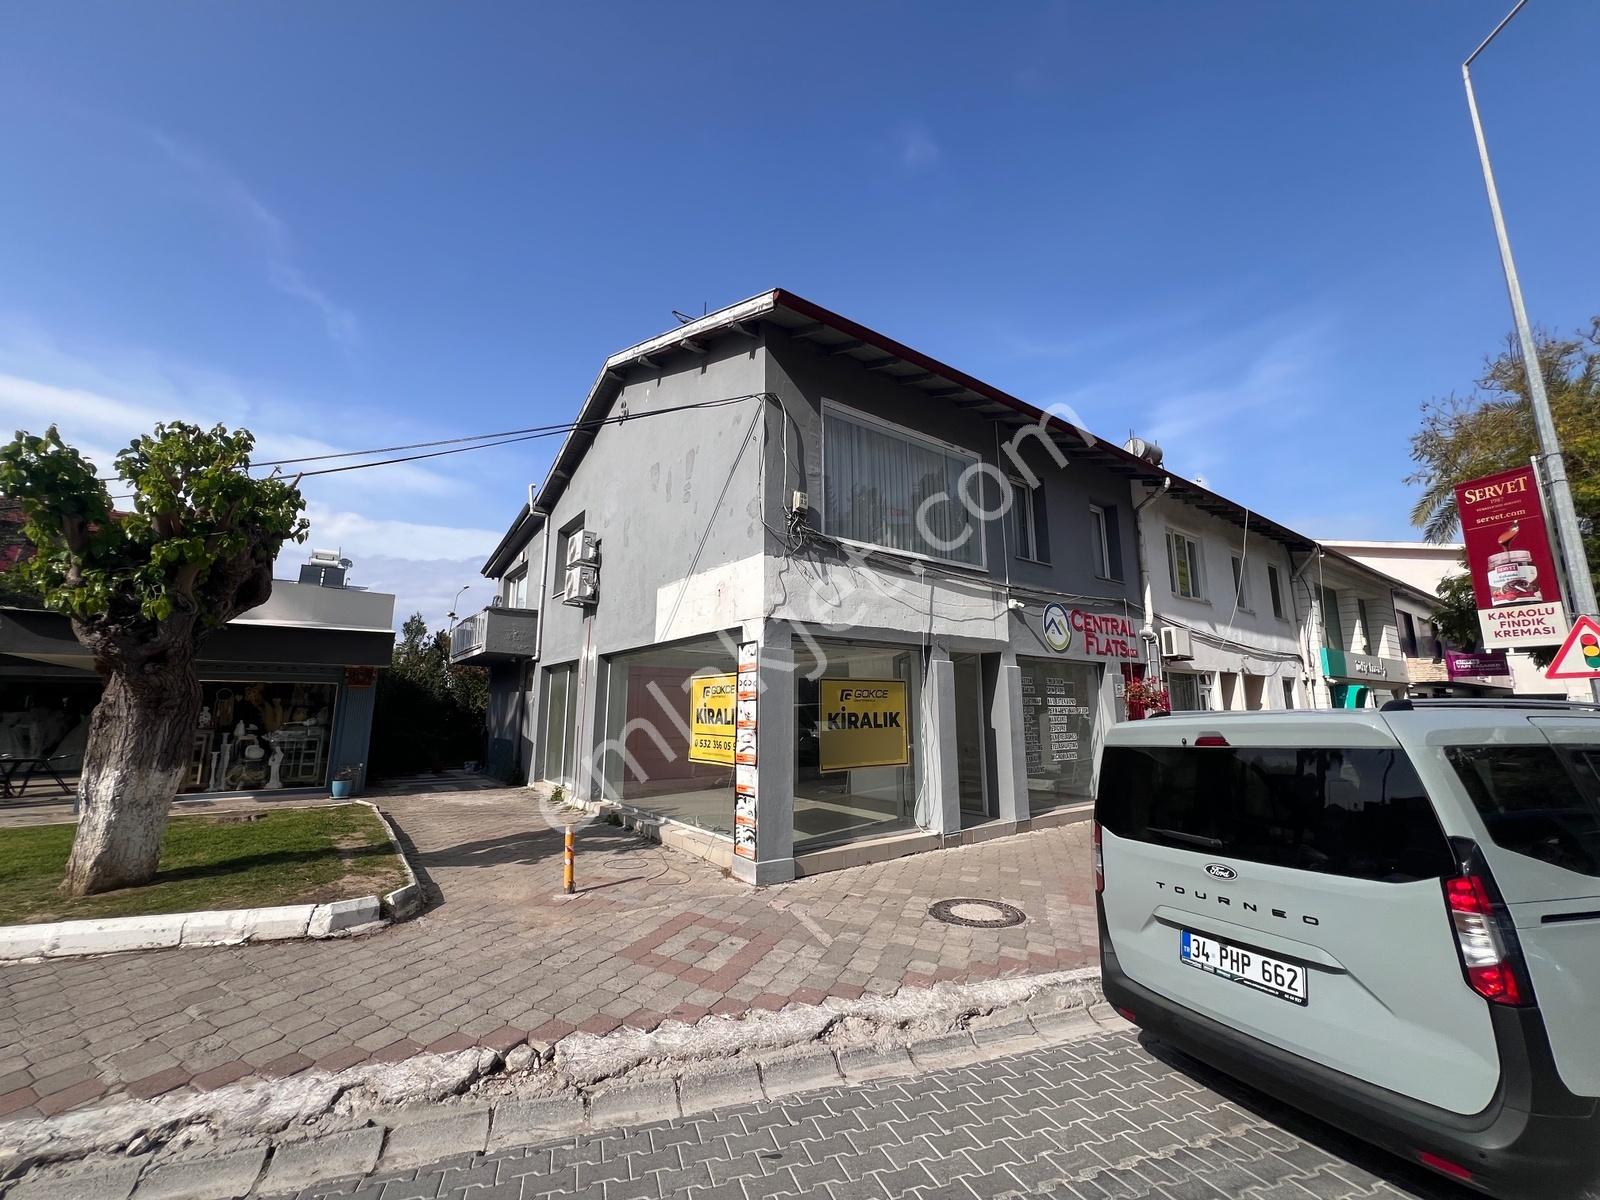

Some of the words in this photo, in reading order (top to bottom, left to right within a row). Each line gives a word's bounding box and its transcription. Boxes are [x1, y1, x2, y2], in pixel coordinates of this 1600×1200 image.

[1464, 476, 1528, 505] SERVET
[1476, 509, 1526, 524] servet.com
[1069, 608, 1136, 638] CENTRAL
[1487, 607, 1555, 621] KAKAOLU
[1499, 617, 1546, 629] FINDIK
[1493, 626, 1556, 639] KREMASI
[1084, 632, 1128, 658] FLATS
[696, 703, 735, 726] KİRALI
[827, 706, 901, 730] KİRALIK
[699, 739, 711, 749] 532
[723, 741, 732, 752] 05
[1208, 864, 1231, 878] Ford
[1156, 881, 1319, 926] TOURNEO
[1192, 938, 1210, 962] 34
[1219, 946, 1251, 974] PHP
[1261, 960, 1299, 993] 662
